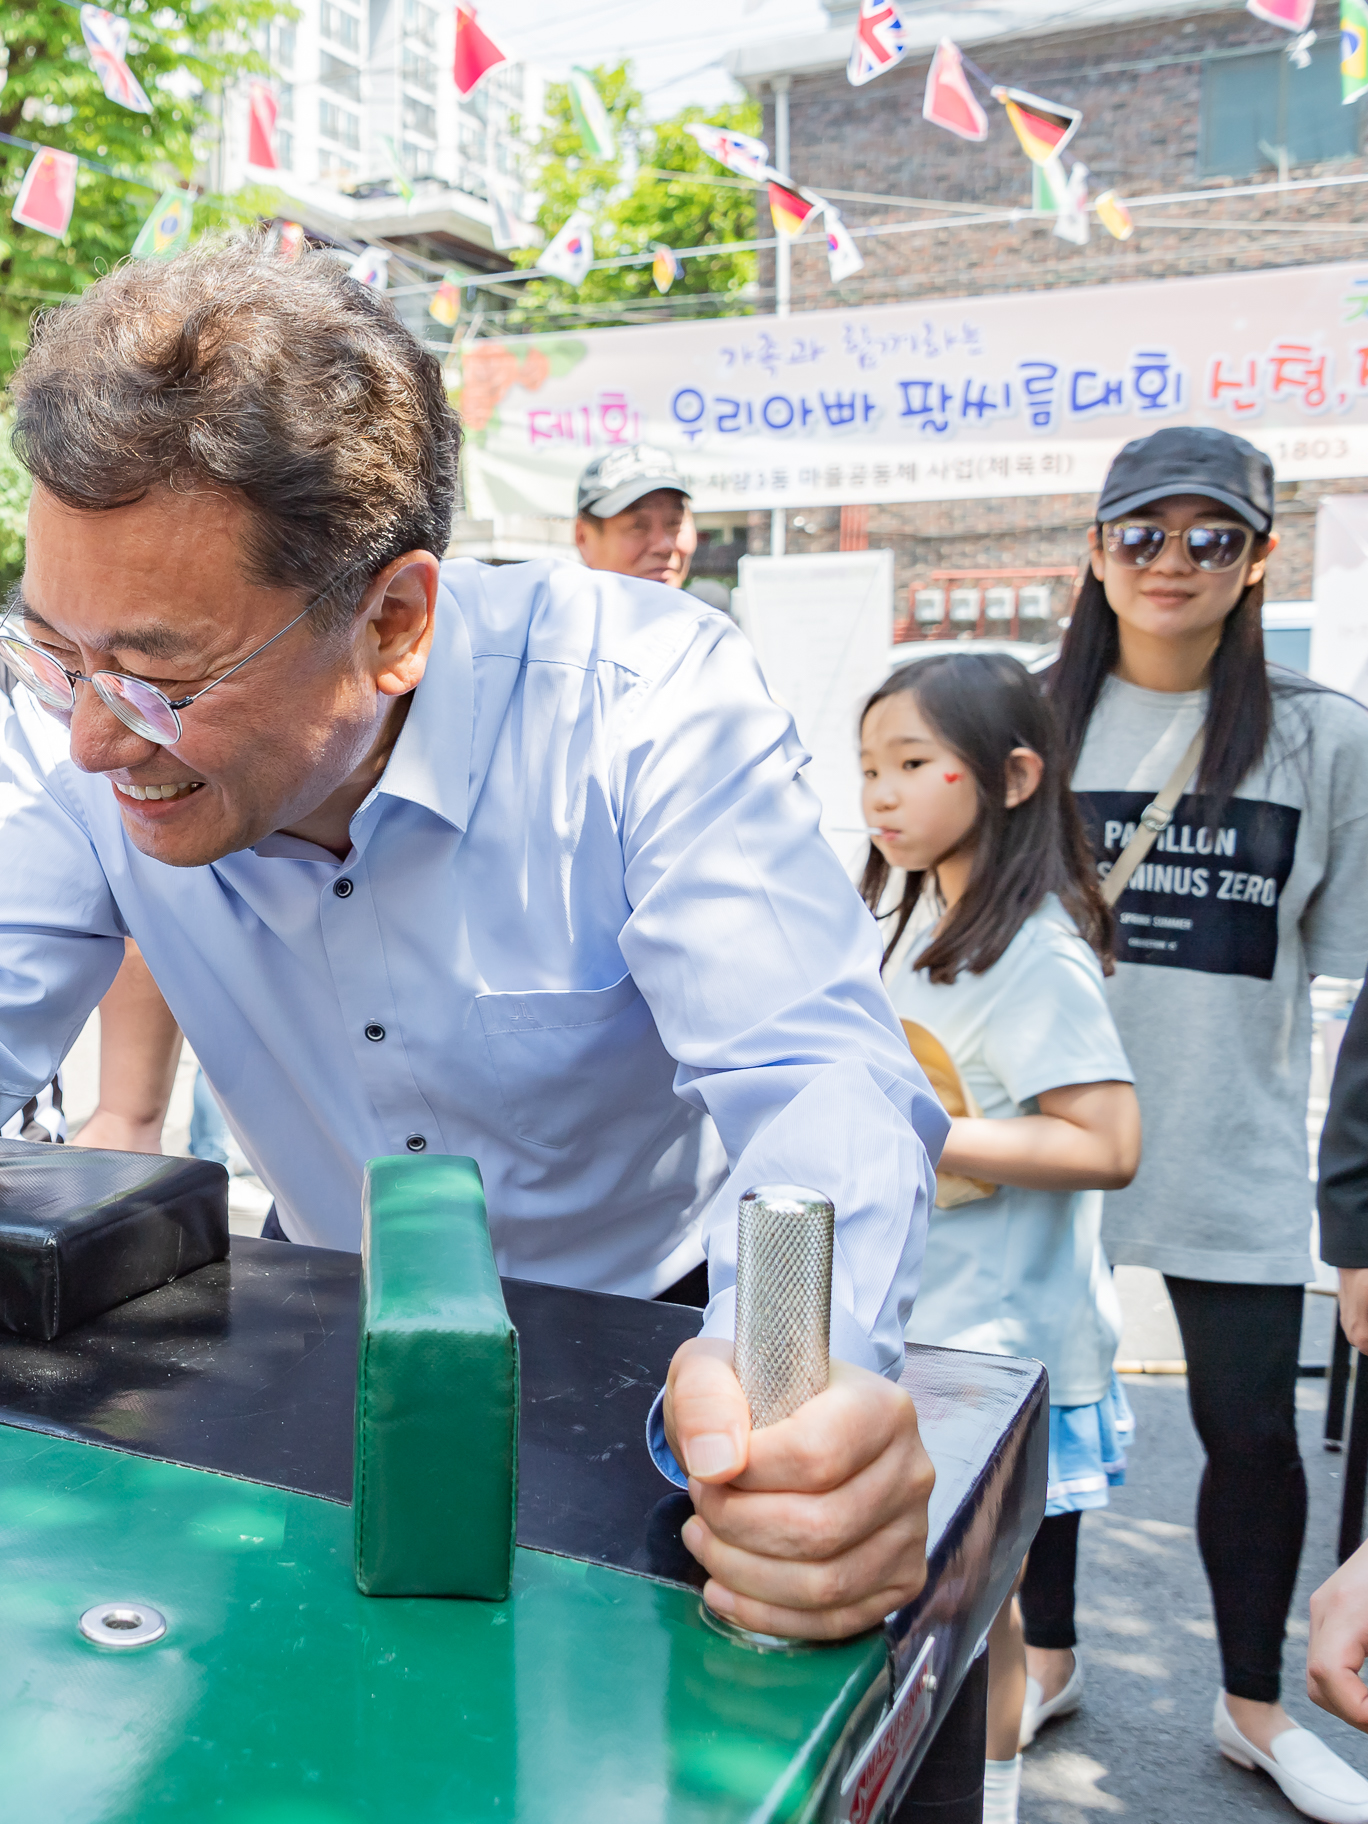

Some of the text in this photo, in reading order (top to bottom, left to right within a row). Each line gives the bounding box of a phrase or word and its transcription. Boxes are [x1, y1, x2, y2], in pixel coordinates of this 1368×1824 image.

[721, 332, 827, 377] 가족과
[527, 392, 639, 446] 제1회
[672, 388, 876, 441] 우리아빠
[899, 353, 1182, 433] 팔씨름대회
[1104, 820, 1237, 857] PAILLON
[1216, 869, 1278, 907] ZERO
